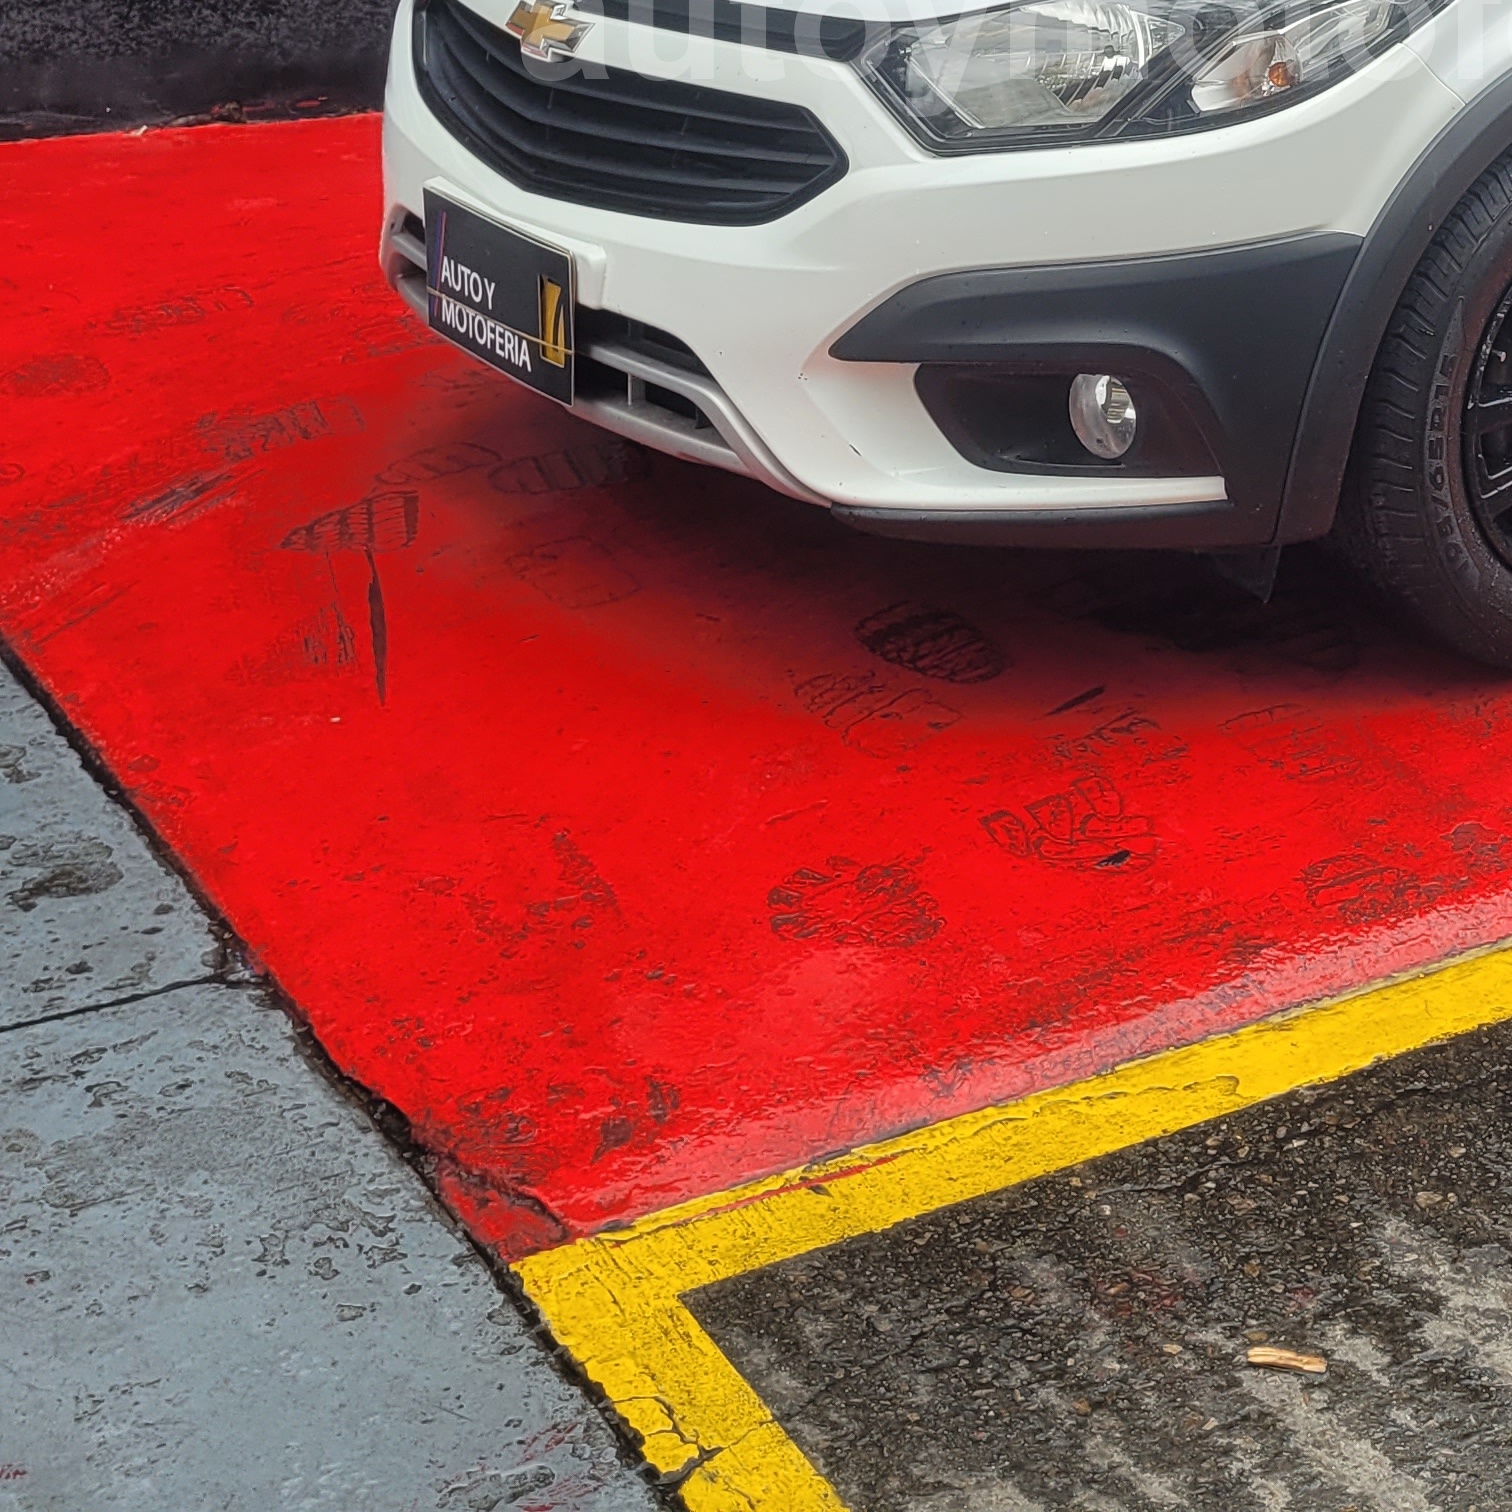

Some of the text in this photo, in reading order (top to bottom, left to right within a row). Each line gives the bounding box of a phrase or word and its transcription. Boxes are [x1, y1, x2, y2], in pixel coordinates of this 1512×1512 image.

[442, 256, 496, 310] AUTO Y
[442, 299, 532, 372] MOTOFERIA
